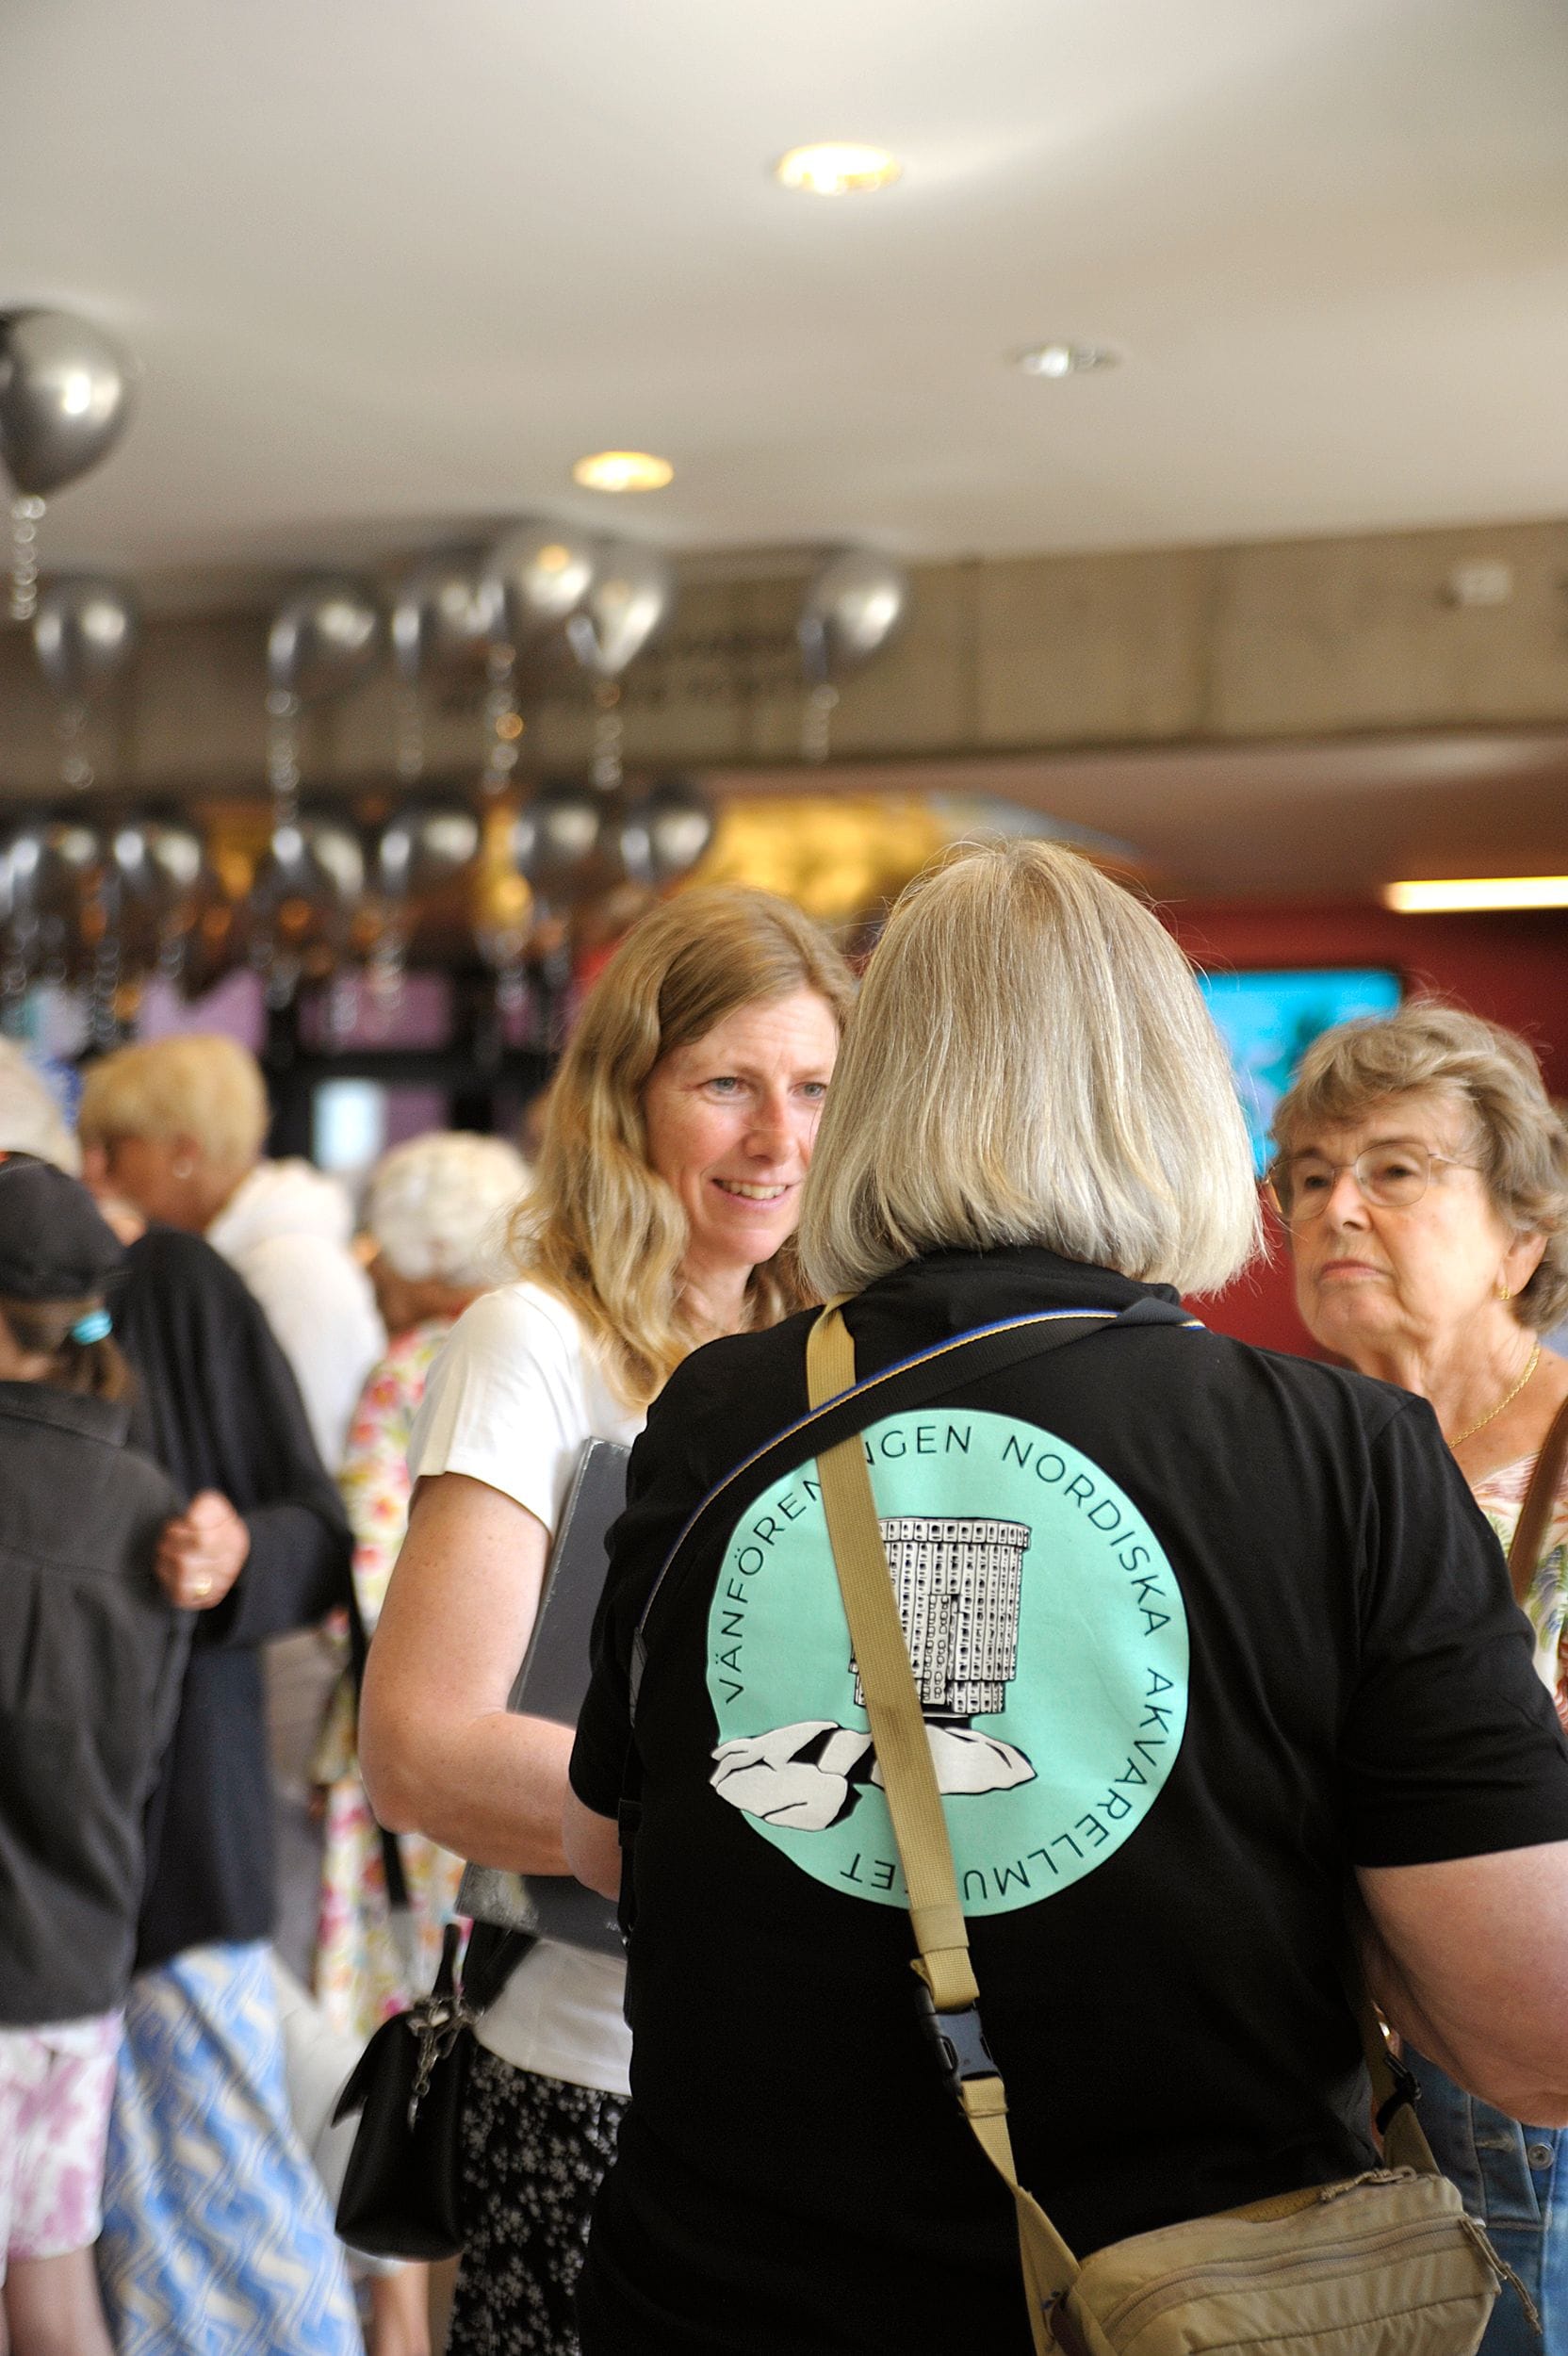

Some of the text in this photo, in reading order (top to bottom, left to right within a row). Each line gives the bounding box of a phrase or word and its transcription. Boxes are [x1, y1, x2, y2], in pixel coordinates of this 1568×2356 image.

[715, 1425, 1173, 1900] VÄNFÖRENGEN NORDISKA AKVARELLMUET
